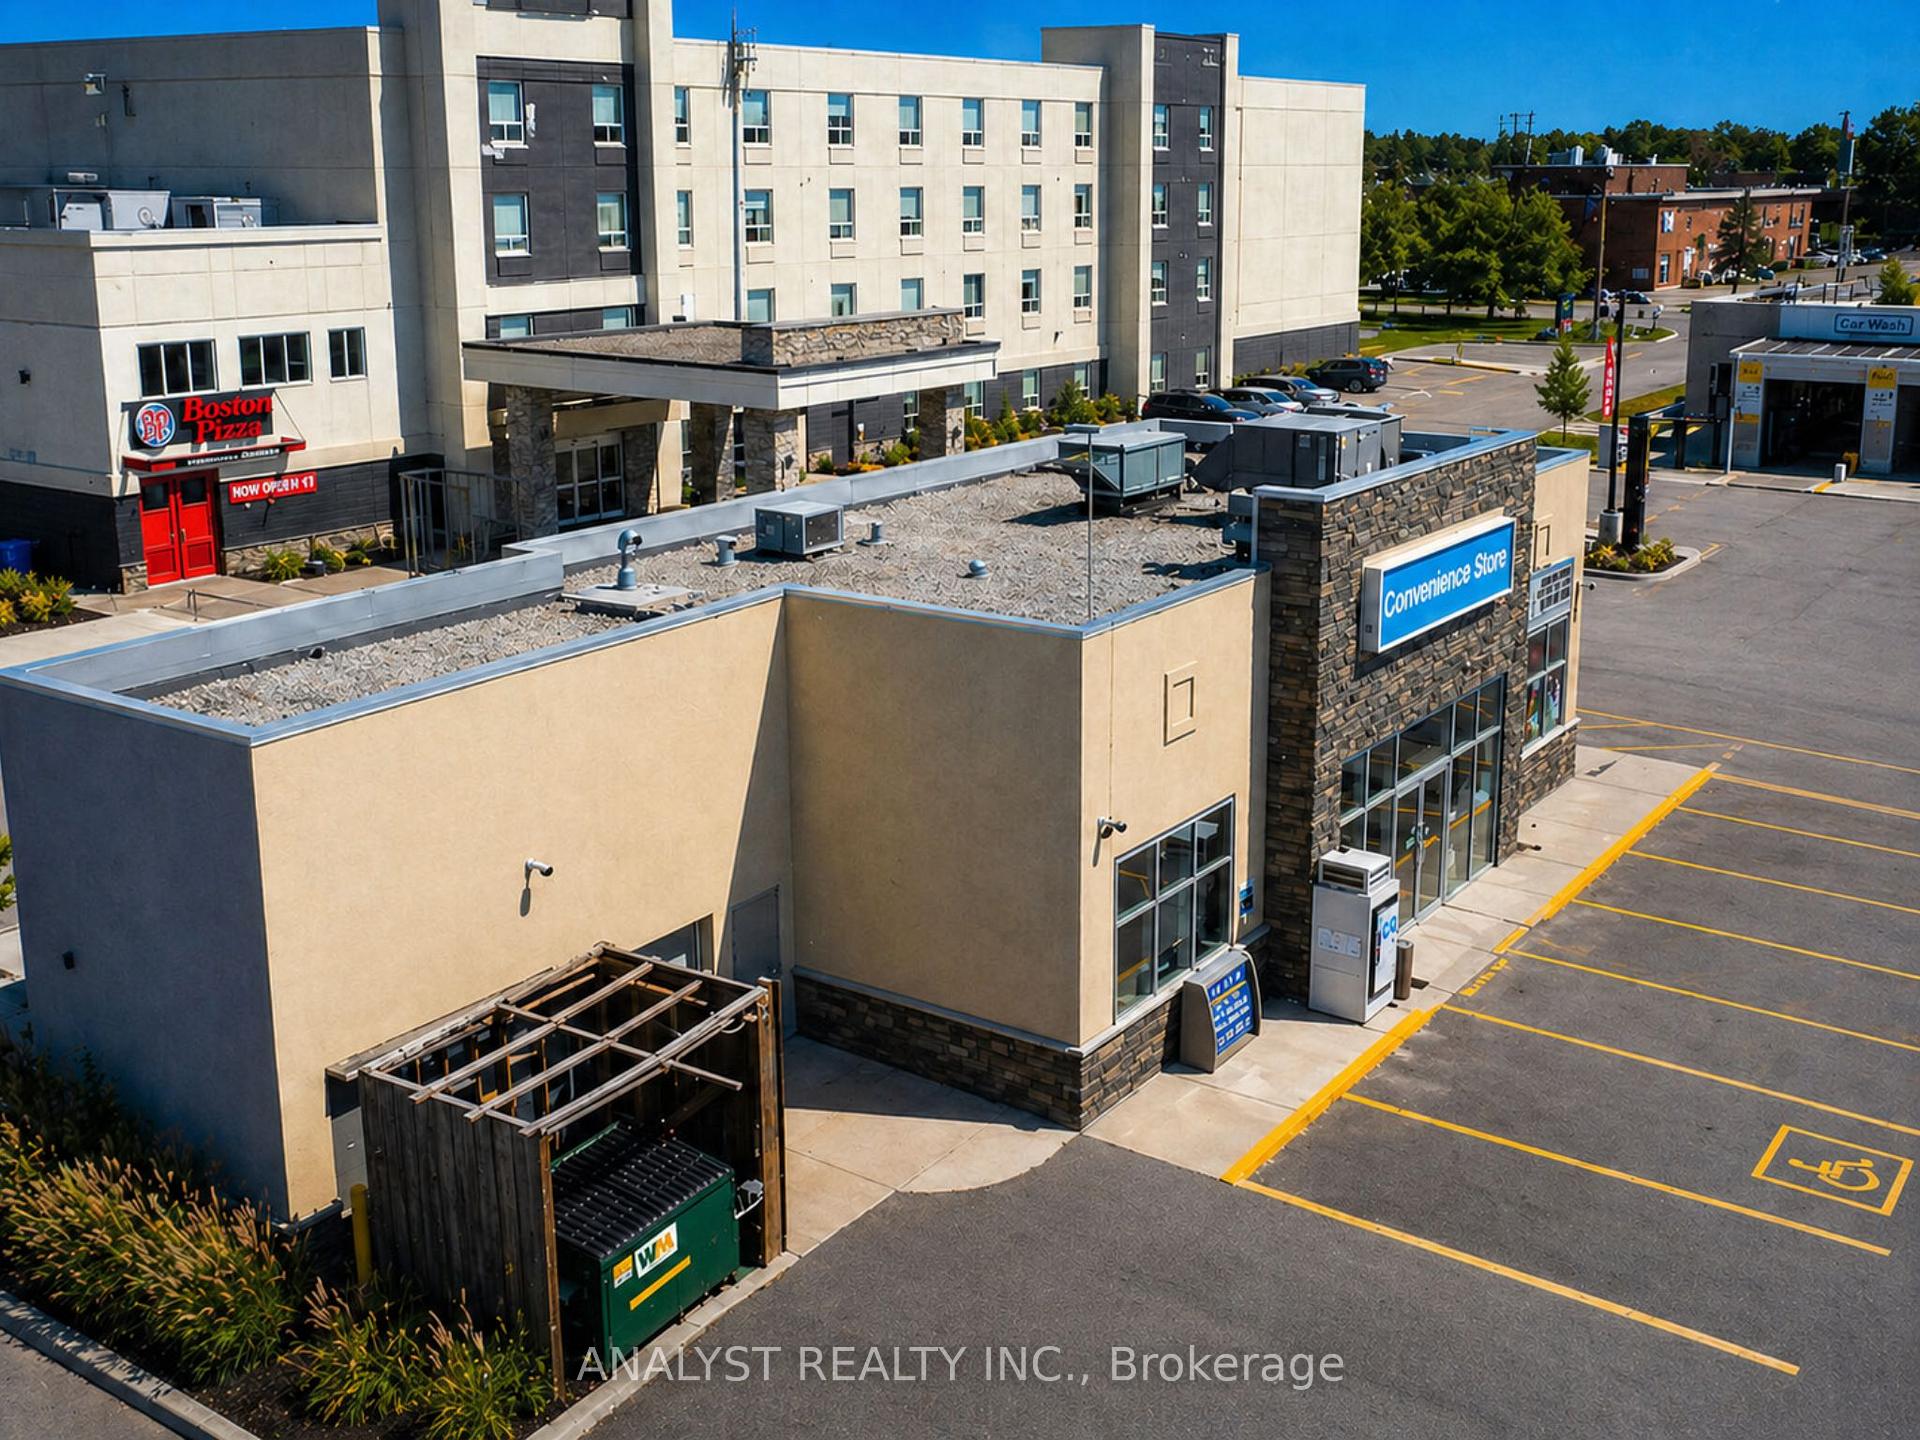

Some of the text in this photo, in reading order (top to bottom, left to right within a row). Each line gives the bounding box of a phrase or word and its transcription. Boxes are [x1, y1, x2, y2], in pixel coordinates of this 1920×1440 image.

[1840, 318, 1905, 331] Car Wash
[183, 396, 272, 422] Boston
[195, 419, 262, 444] Pizza
[232, 482, 260, 498] NOW
[1384, 549, 1506, 618] Convenience Store
[638, 1232, 674, 1271] WM
